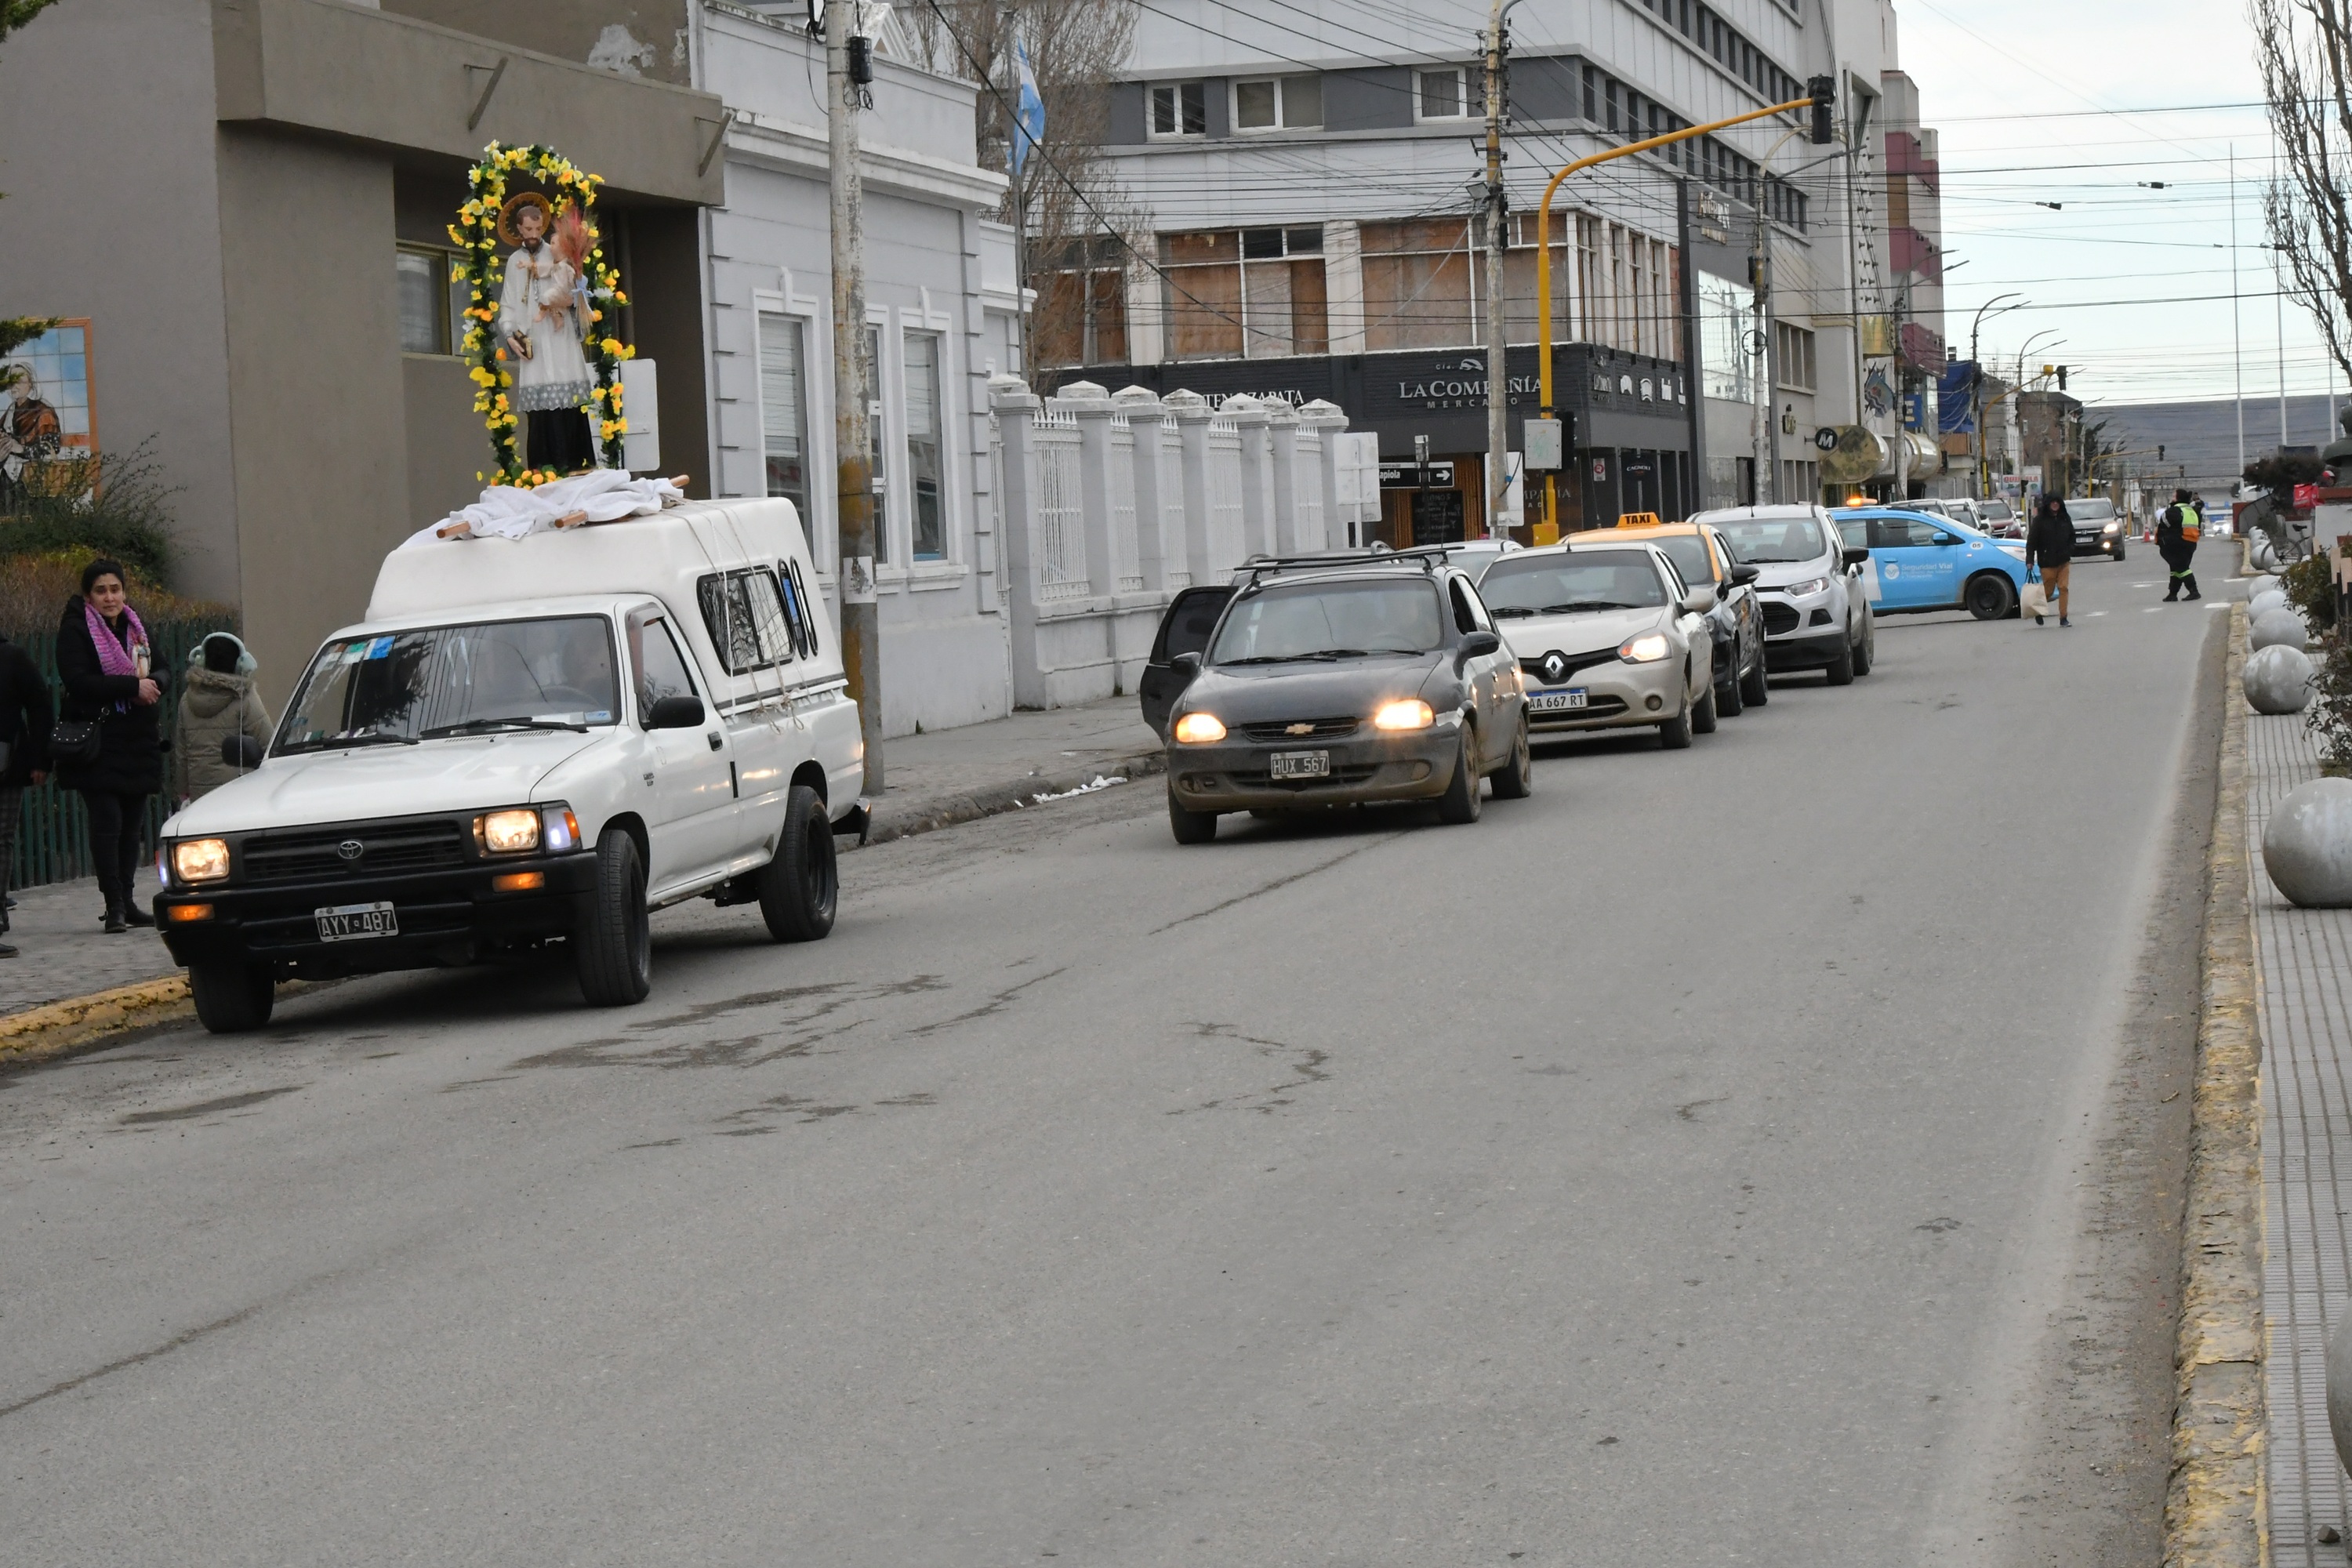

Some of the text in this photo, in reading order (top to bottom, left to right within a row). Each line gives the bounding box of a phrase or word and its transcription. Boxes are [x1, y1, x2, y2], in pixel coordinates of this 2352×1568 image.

[1428, 397, 1518, 408] MERCAO
[1380, 470, 1401, 481] apiola
[1624, 514, 1650, 524] TAXI
[1530, 695, 1583, 709] AA 667 RT
[1273, 757, 1327, 774] HUX 567
[321, 911, 391, 935] AYY 487
